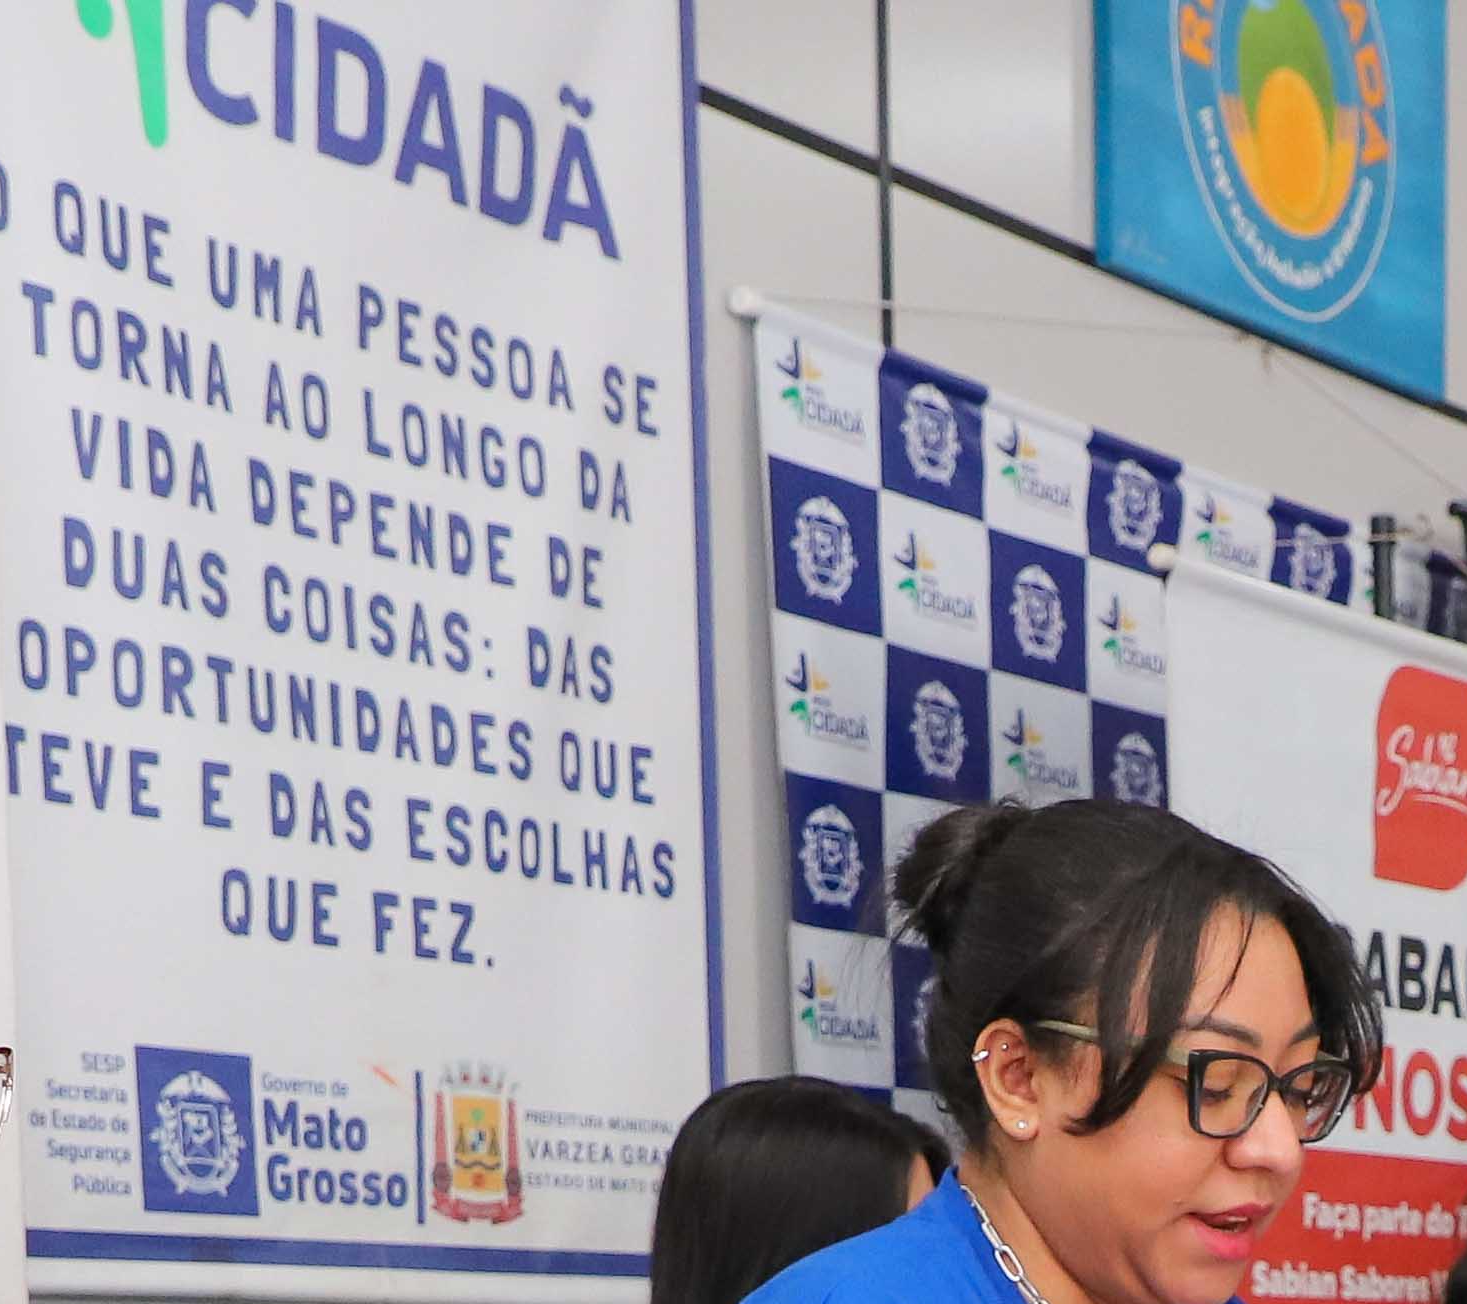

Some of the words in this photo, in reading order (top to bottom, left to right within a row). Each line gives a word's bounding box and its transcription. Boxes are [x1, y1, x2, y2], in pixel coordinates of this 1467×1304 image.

[185, 0, 620, 260] CIDADÃ
[54, 181, 174, 287] QUE
[208, 237, 322, 336] UMA
[358, 284, 574, 411] PESSOA
[601, 364, 659, 437] SE
[21, 281, 232, 412] TORNA
[264, 362, 329, 441] AO
[362, 390, 546, 497] LONGO
[579, 451, 632, 525] DA
[71, 408, 215, 512] VIDA
[248, 457, 516, 589] DEPENDE
[548, 536, 604, 609] DE
[64, 516, 228, 620] DUAS
[262, 565, 495, 680] COISAS:
[528, 626, 614, 704] DAS
[18, 620, 532, 780] OPORTUNIDADES
[559, 735, 656, 806] QUE
[203, 761, 233, 830] E
[269, 773, 374, 852] DAS
[407, 797, 677, 900] ESCOLHAS
[222, 868, 339, 948] QUE
[373, 889, 497, 969] FEZ.
[29, 1111, 46, 1128] de
[51, 1111, 106, 1131] Estado
[111, 1114, 129, 1133] de
[44, 1079, 128, 1103] Secretaria
[261, 1073, 325, 1098] Governo
[331, 1080, 349, 1097] de
[262, 1097, 369, 1152] Mato
[47, 1139, 132, 1166] Segurança
[266, 1154, 409, 1208] Grosso
